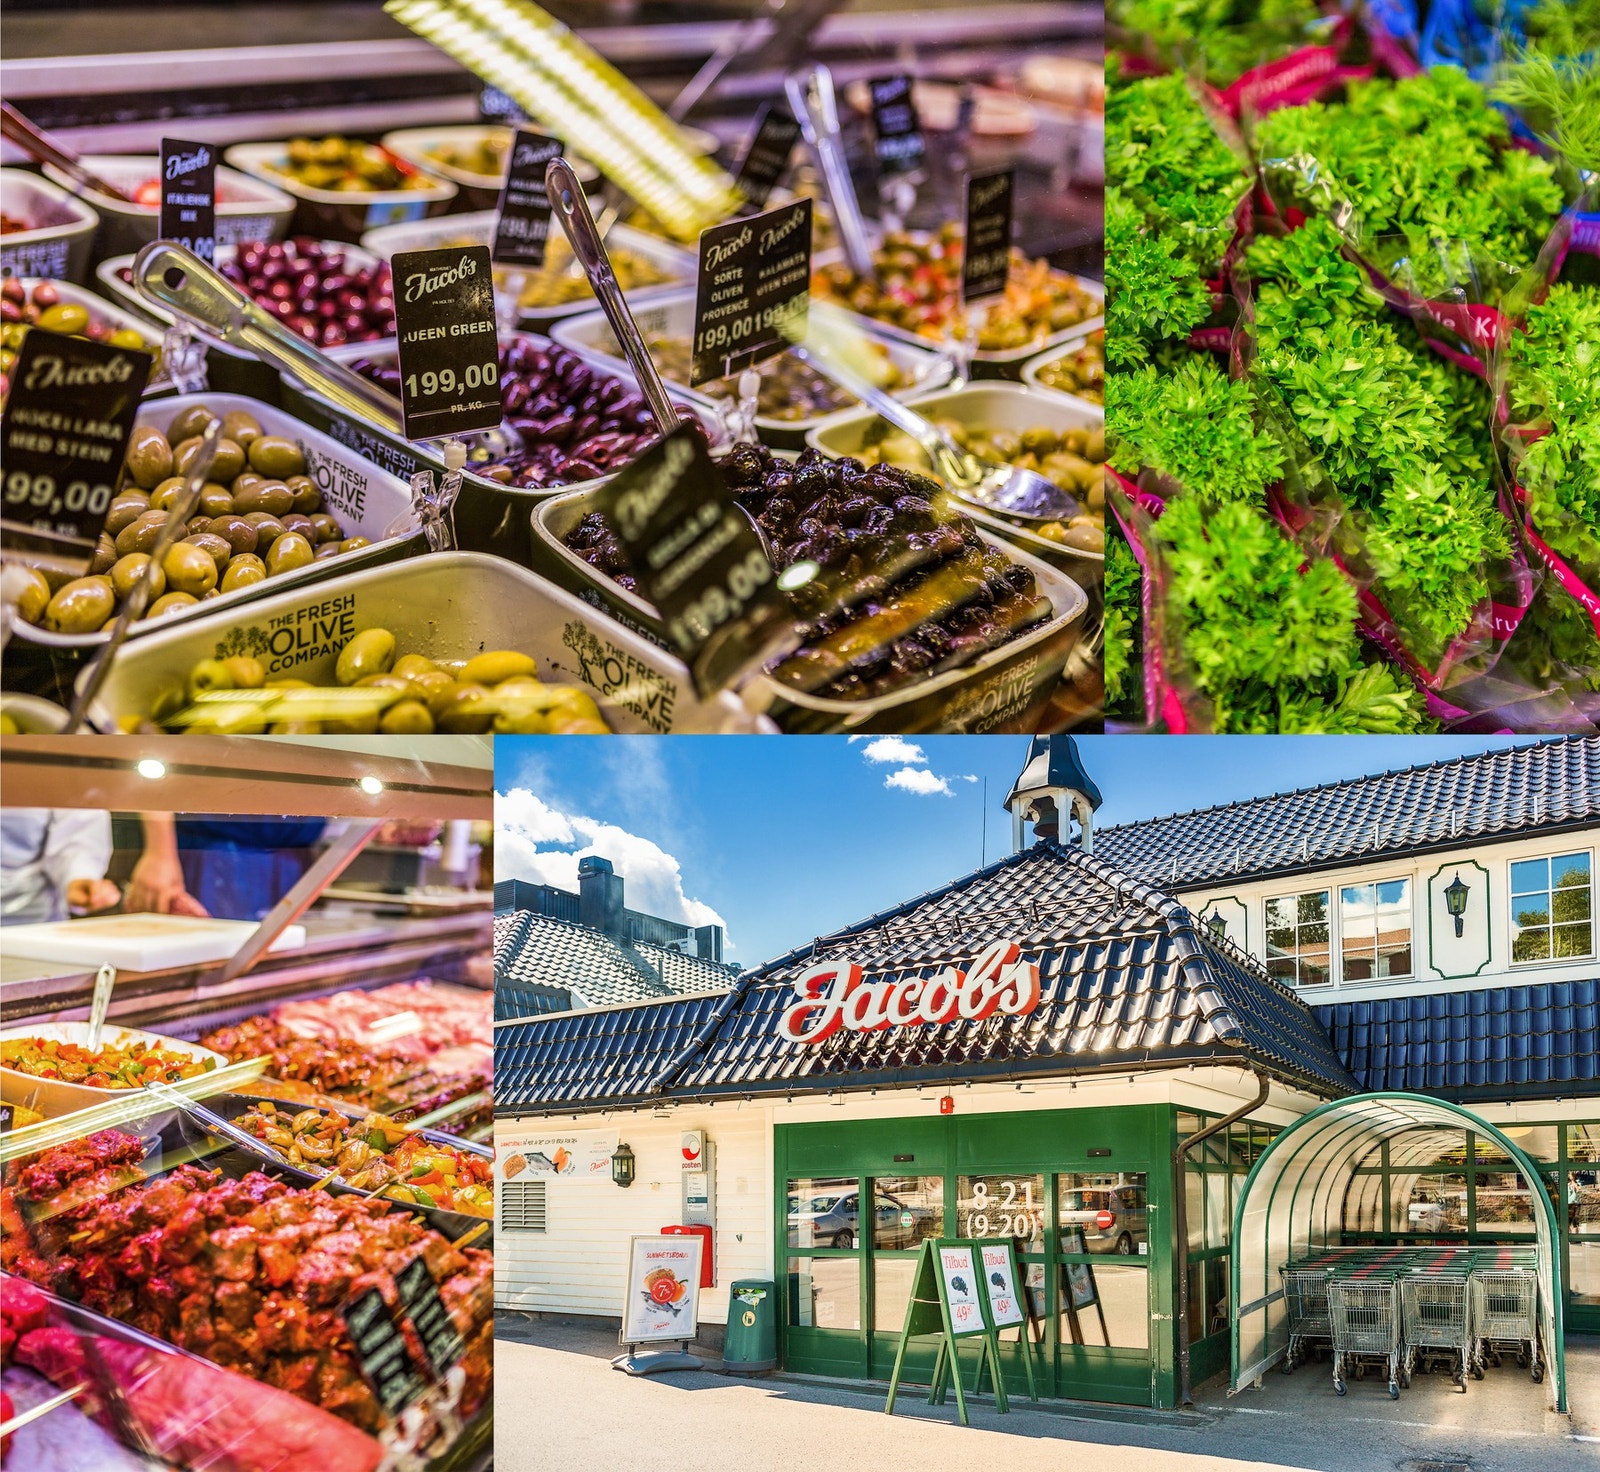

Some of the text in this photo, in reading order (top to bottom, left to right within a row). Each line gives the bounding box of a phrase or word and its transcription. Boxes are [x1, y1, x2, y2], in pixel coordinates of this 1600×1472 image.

[759, 206, 805, 256] Jacob's
[705, 225, 753, 272] Jacob's
[405, 255, 476, 302] Jacob's
[714, 267, 743, 285] SORTE
[756, 266, 807, 297] UTEN STEIN
[759, 251, 806, 280] KALAMATA
[711, 283, 744, 303] OLIVEN
[702, 298, 749, 323] PROVENCE
[450, 320, 494, 337] GREEN
[698, 316, 752, 352] 199,00
[405, 362, 498, 398] 199,00
[451, 401, 485, 413] PR. KG.
[9, 431, 112, 462] MED STEIN
[361, 434, 376, 449] THE
[377, 442, 416, 472] FRESH
[317, 465, 366, 511] OLIVE
[318, 453, 332, 468] THE
[333, 461, 367, 490] FRESH
[322, 492, 364, 523] OMPANY
[268, 594, 355, 630] THE FRESH
[270, 611, 355, 656] OLIVE
[605, 641, 625, 662] THE
[984, 655, 1039, 691] THE FRESH
[981, 672, 1035, 717] OLIVE
[975, 695, 1031, 734] COMPANY
[779, 939, 1040, 1044] Jacob's
[972, 1181, 1032, 1211] 8-21
[966, 1213, 1037, 1243] (9-20)
[943, 1255, 968, 1269] Tilbud
[984, 1253, 1006, 1266] Tilbud
